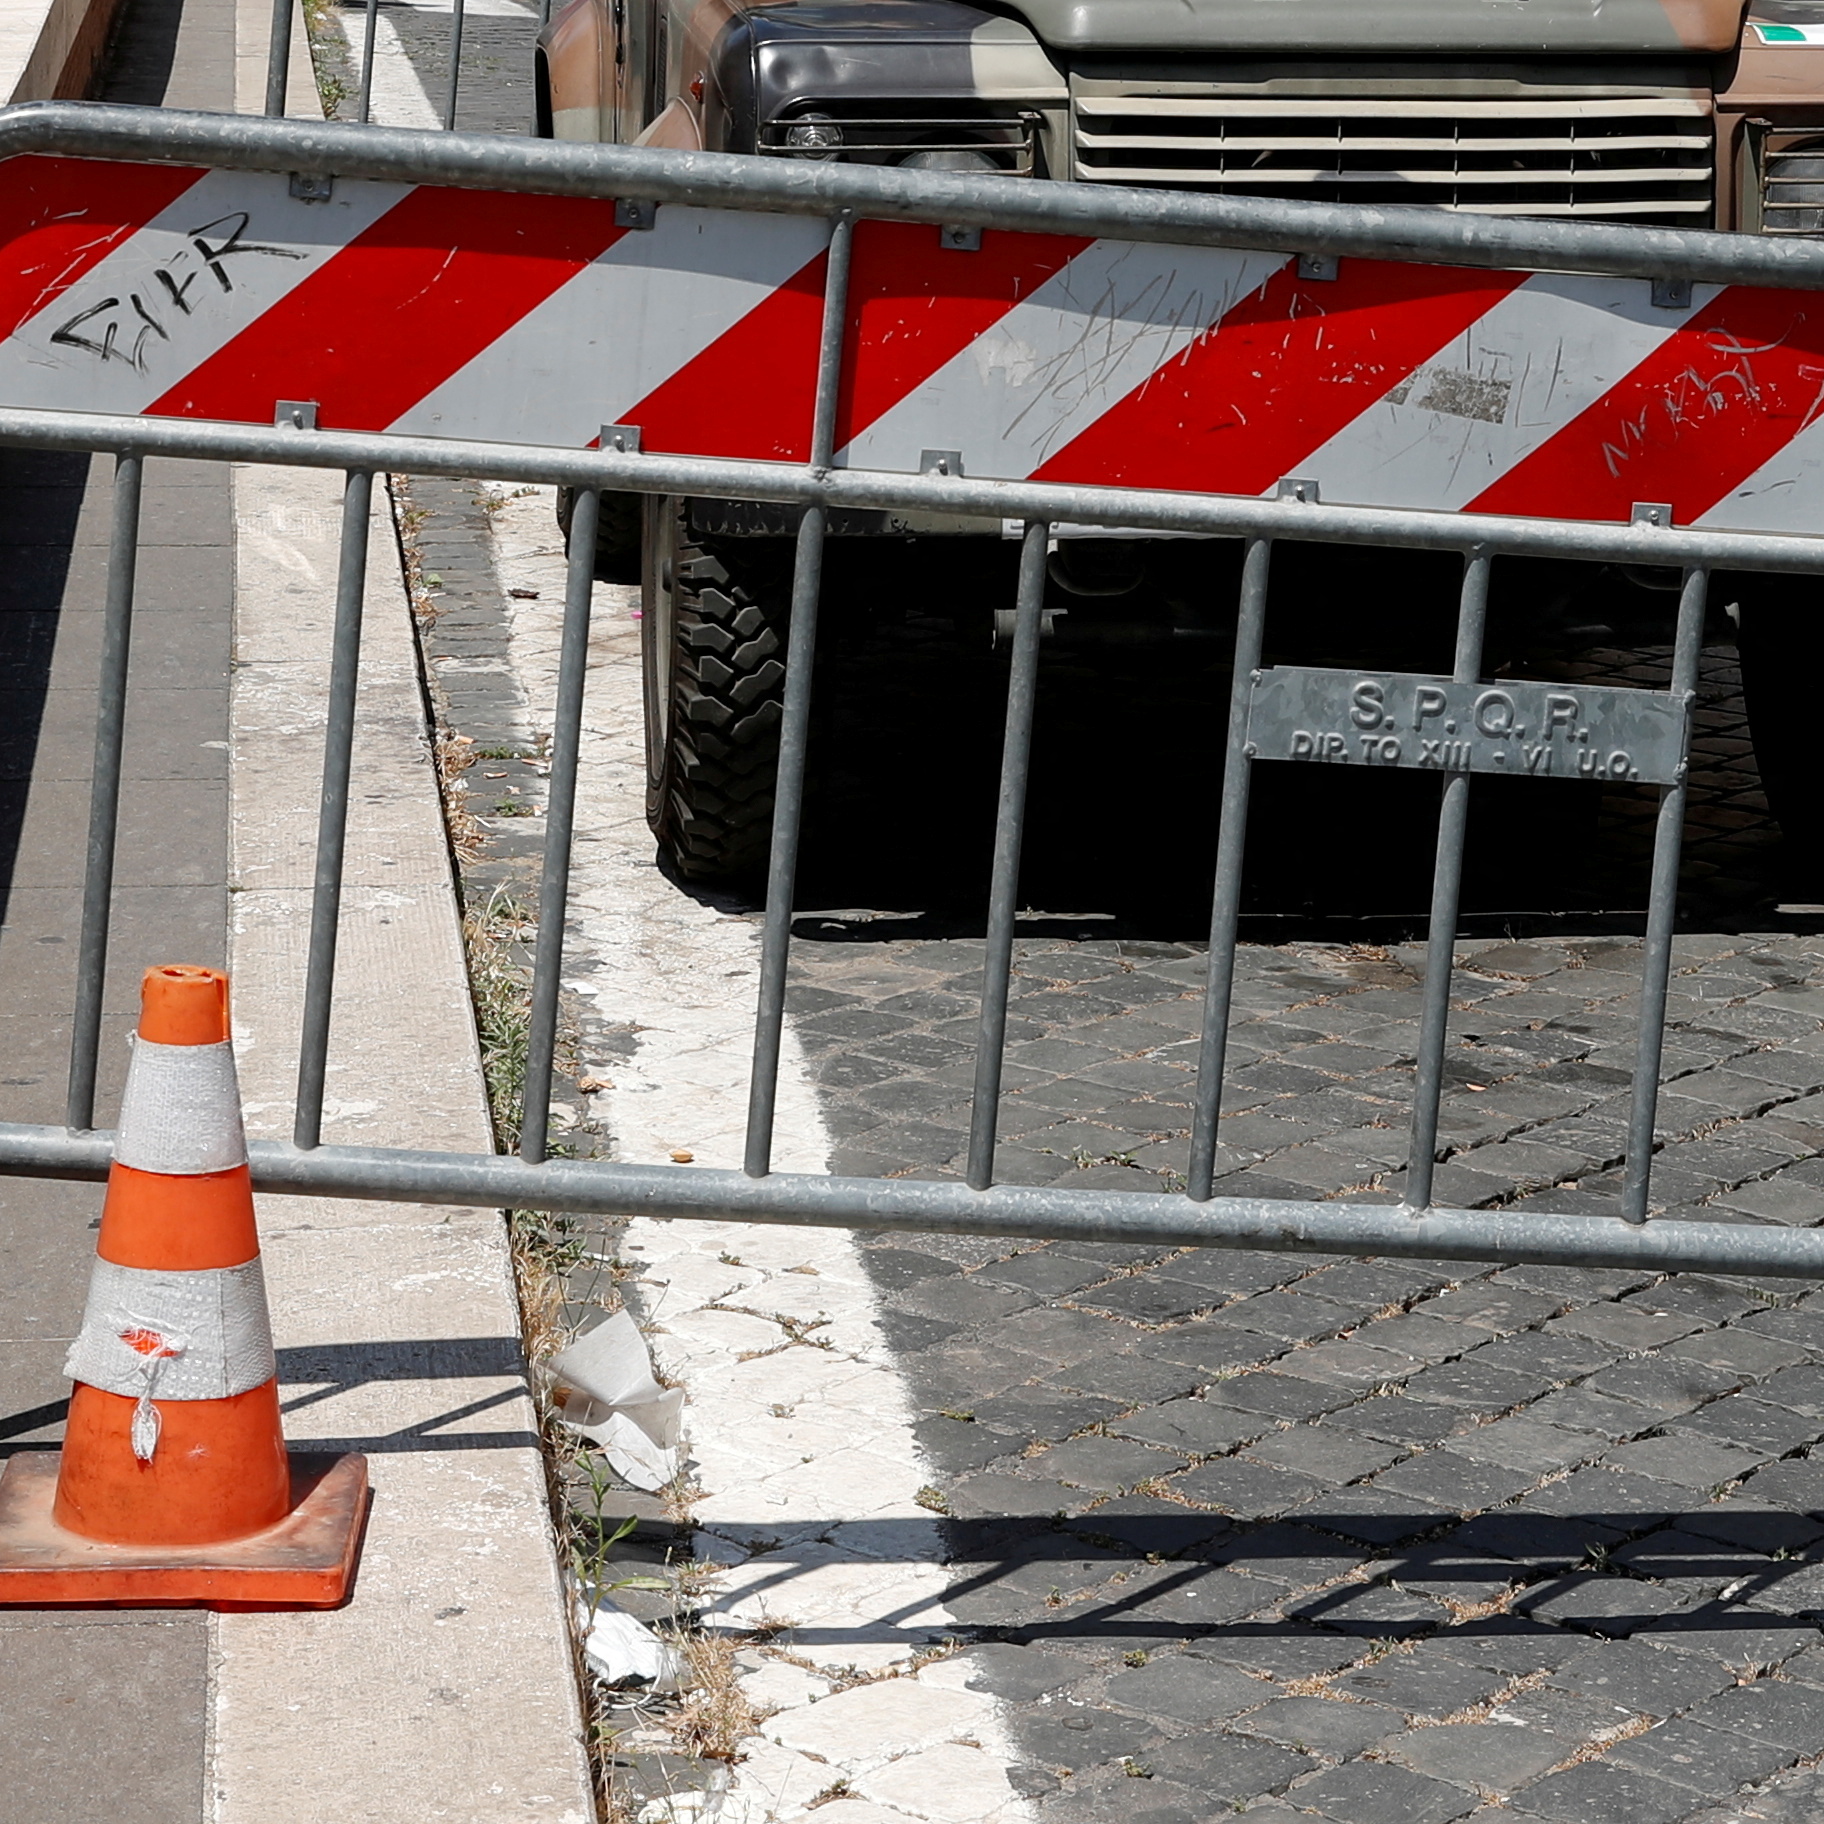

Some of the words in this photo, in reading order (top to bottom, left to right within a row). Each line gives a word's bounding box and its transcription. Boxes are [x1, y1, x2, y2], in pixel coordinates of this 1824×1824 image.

[1290, 729, 1348, 764] DIP.
[1359, 733, 1402, 766] TO
[1417, 737, 1472, 772] XIII
[1522, 744, 1552, 775] VI
[1576, 747, 1639, 779] U.O.
